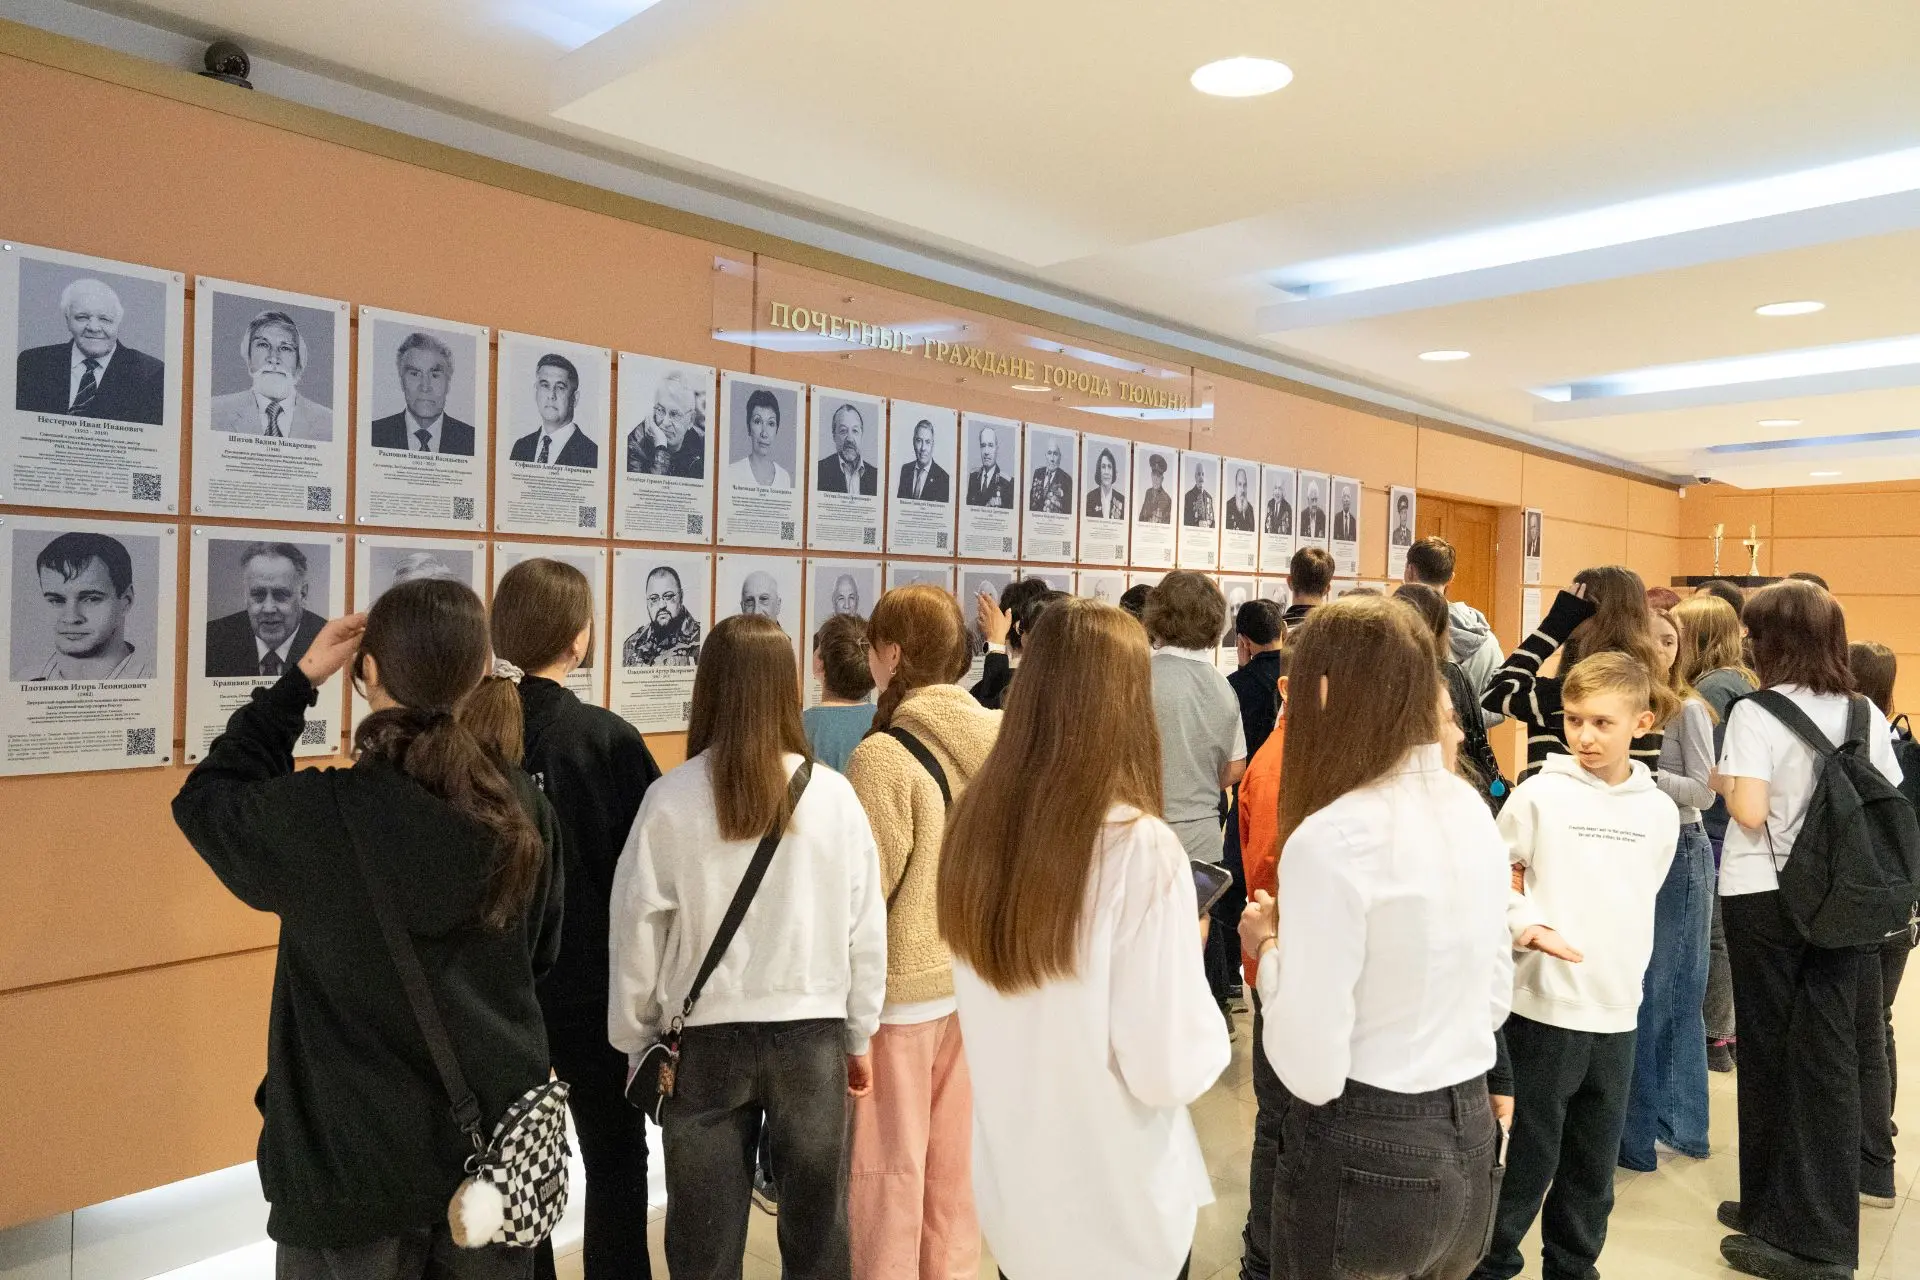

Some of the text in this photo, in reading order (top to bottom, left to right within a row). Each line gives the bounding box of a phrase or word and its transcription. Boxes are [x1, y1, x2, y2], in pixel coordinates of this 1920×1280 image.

[769, 301, 1188, 413] ПОЧЕТНЫЕ ГРАЖДАНЕ ГОРОДА ТЮМЕНИ
[38, 415, 144, 433] Нестеров Иван Иванович
[20, 682, 147, 692] Плотников Игорь Леонидович
[212, 680, 250, 688] Крапивин
